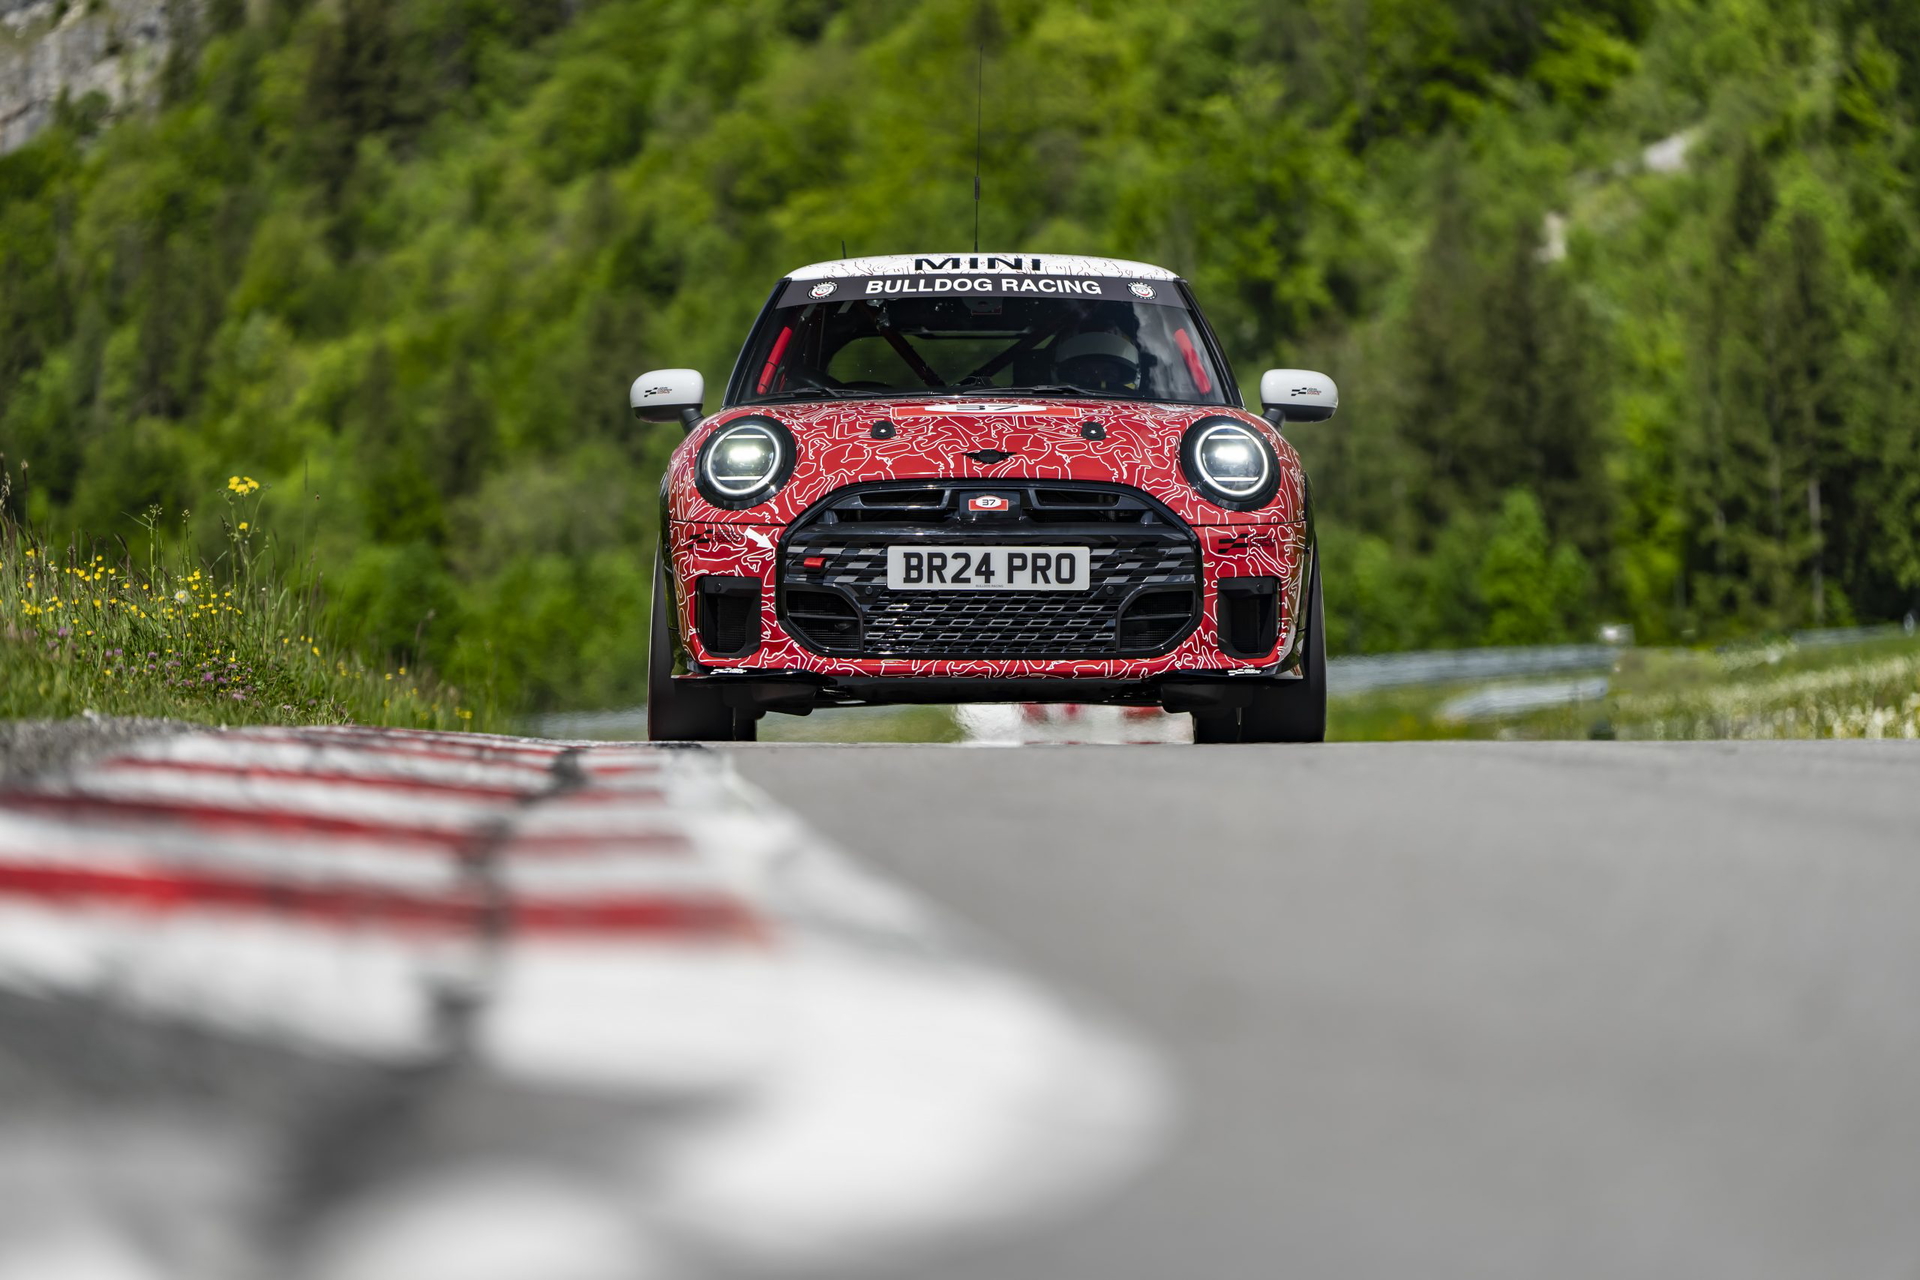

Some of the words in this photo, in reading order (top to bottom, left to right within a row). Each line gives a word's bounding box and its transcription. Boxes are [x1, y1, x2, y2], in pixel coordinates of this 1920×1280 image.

[914, 257, 1041, 271] MINI
[865, 278, 993, 294] BULLDOG
[1001, 278, 1102, 295] RACING
[903, 552, 995, 584] BR24
[1007, 552, 1076, 585] PRO
